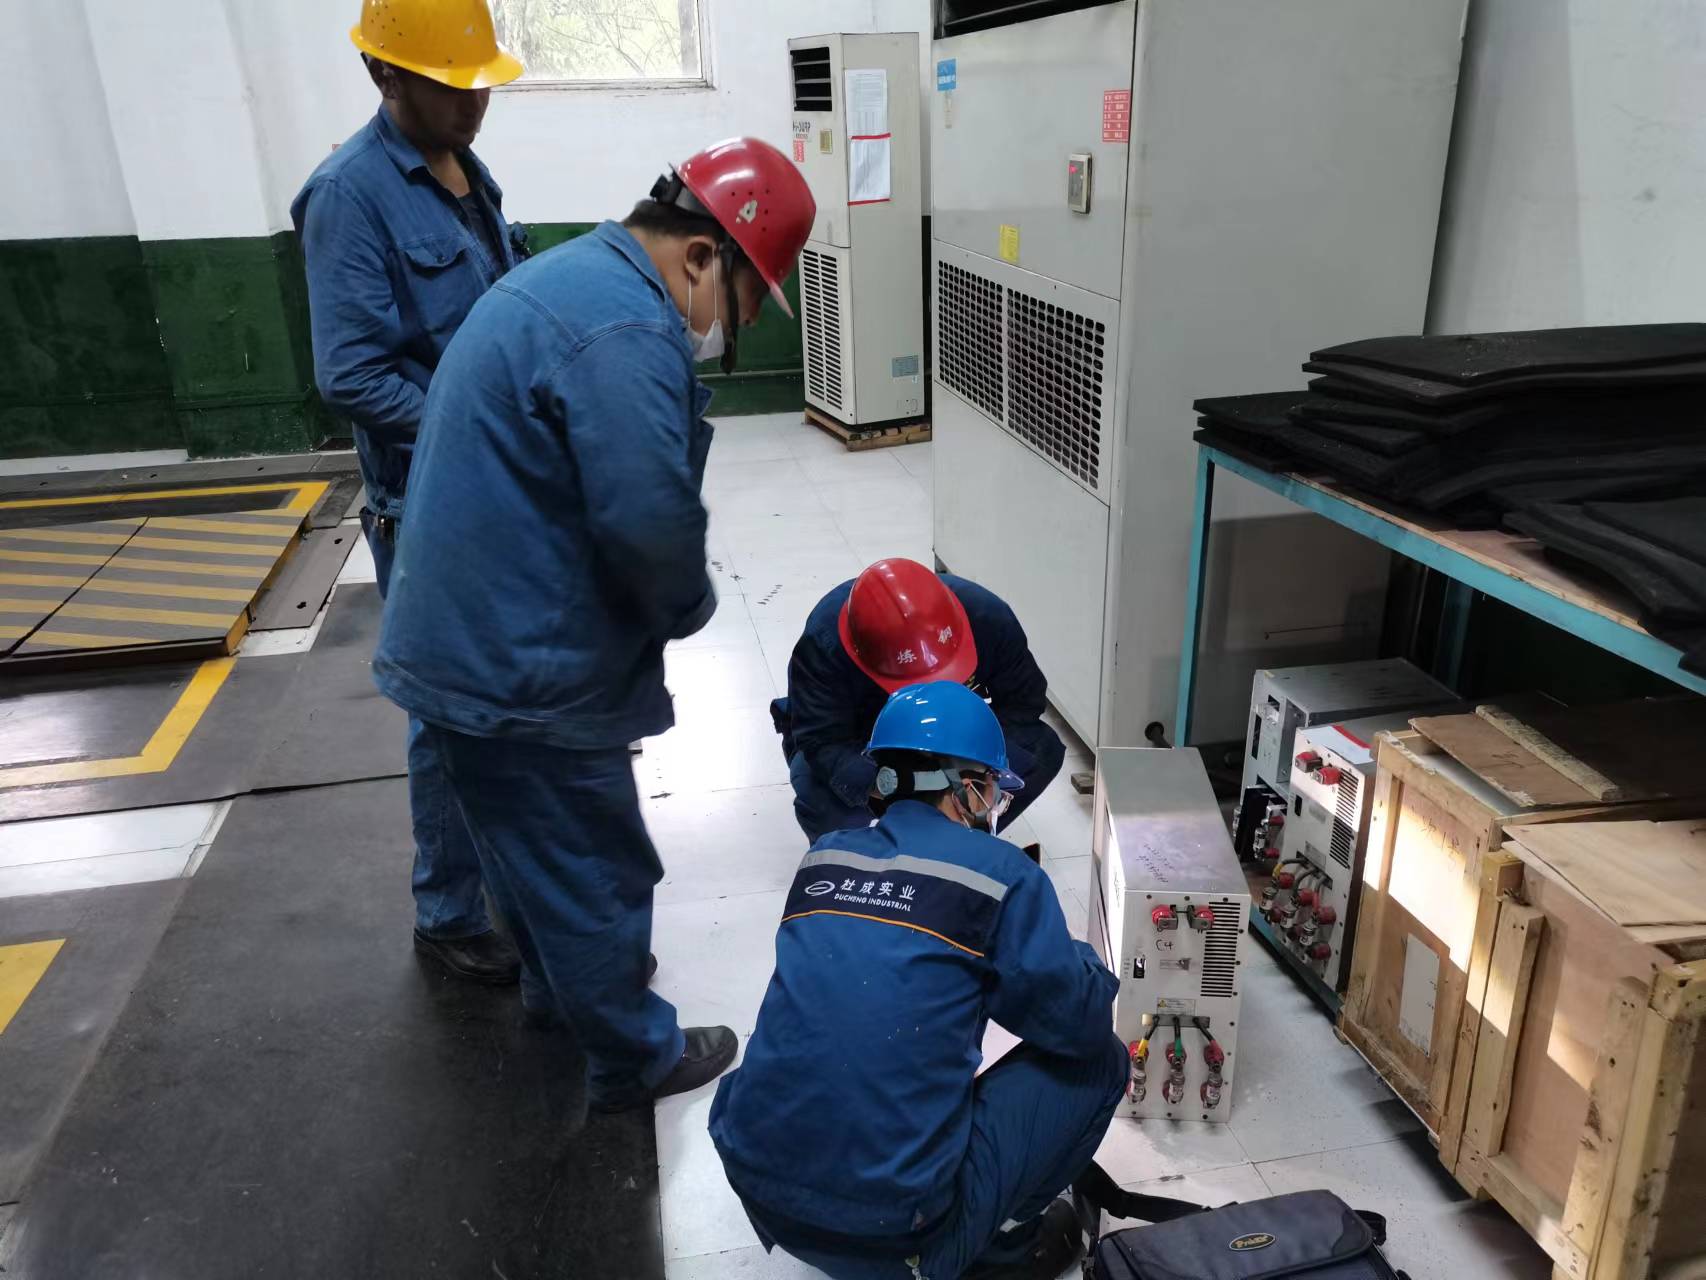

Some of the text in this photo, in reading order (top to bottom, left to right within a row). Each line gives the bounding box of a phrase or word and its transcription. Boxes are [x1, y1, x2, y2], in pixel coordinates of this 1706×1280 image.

[840, 878, 916, 900] 杜成实业
[834, 893, 911, 912] DUCHENG INDUSTRIAL
[1156, 939, 1173, 952] C4
